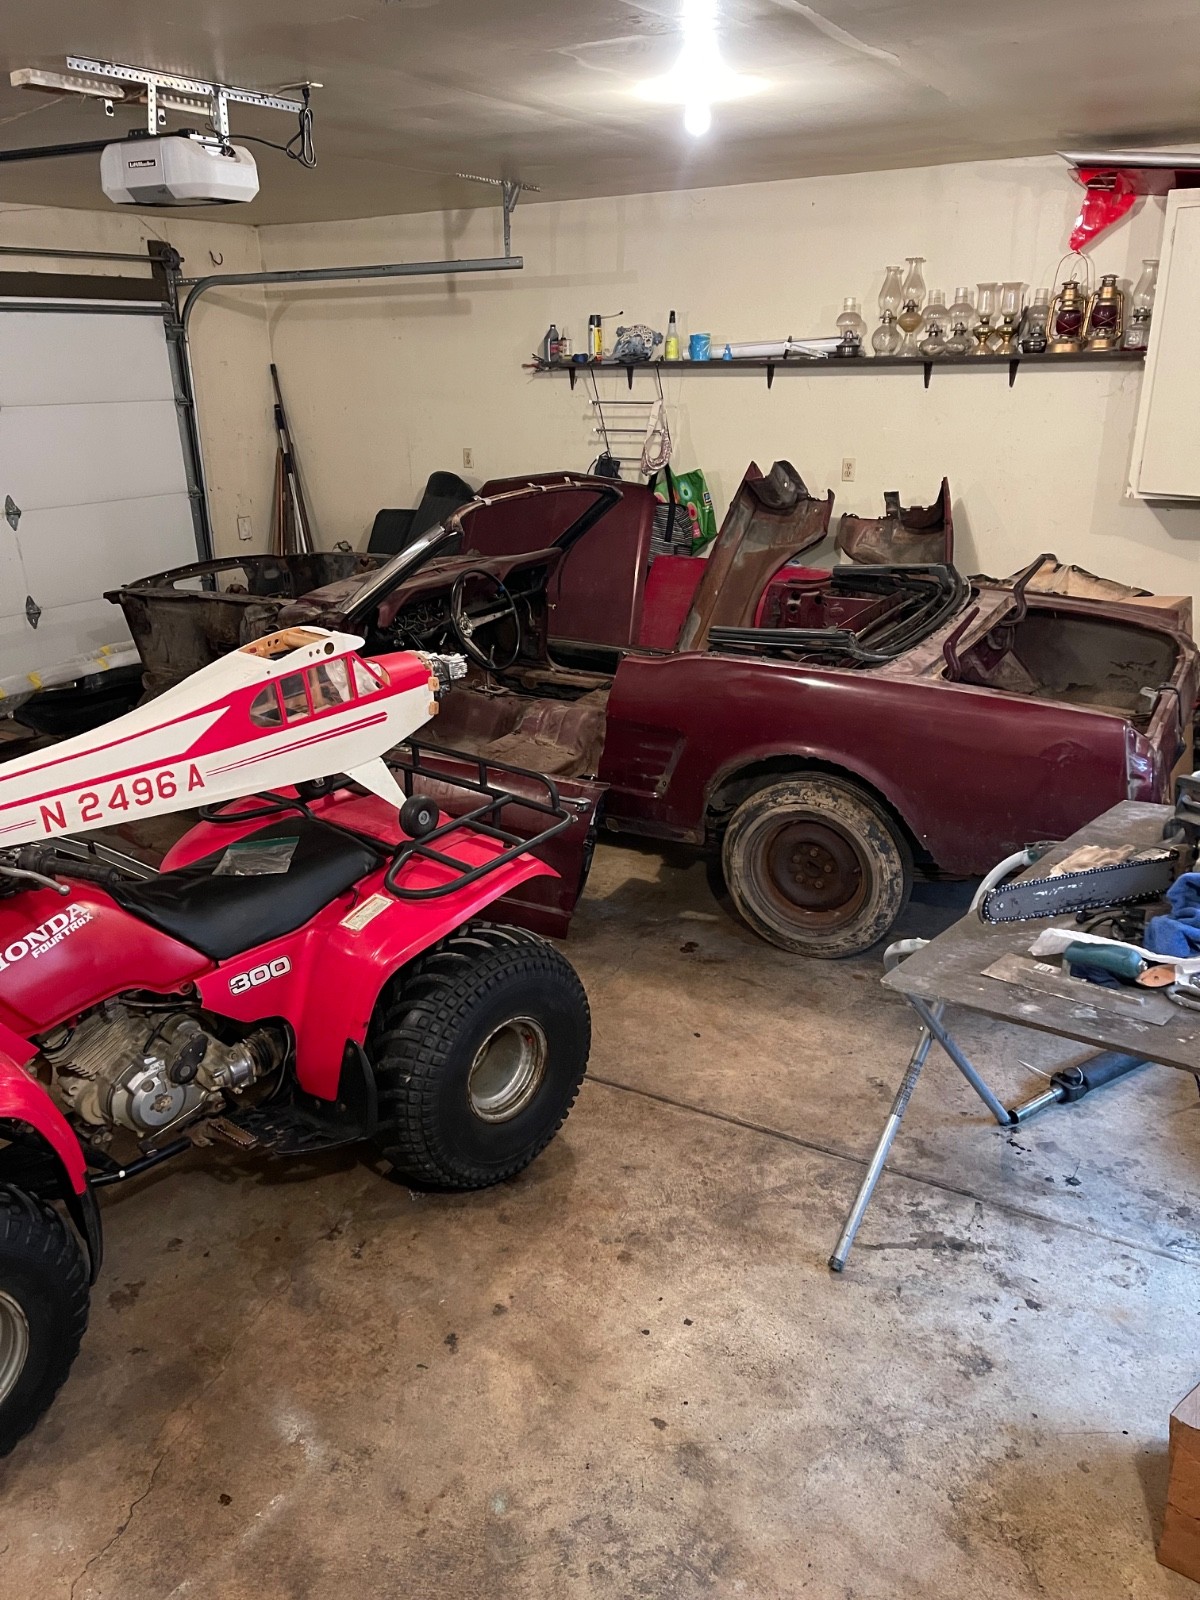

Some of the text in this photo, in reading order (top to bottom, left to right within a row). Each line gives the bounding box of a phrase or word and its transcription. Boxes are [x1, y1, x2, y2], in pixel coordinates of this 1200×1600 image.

[40, 763, 205, 833] N 2496 A
[31, 912, 94, 959] FOURTRAX
[229, 956, 292, 995] 300
